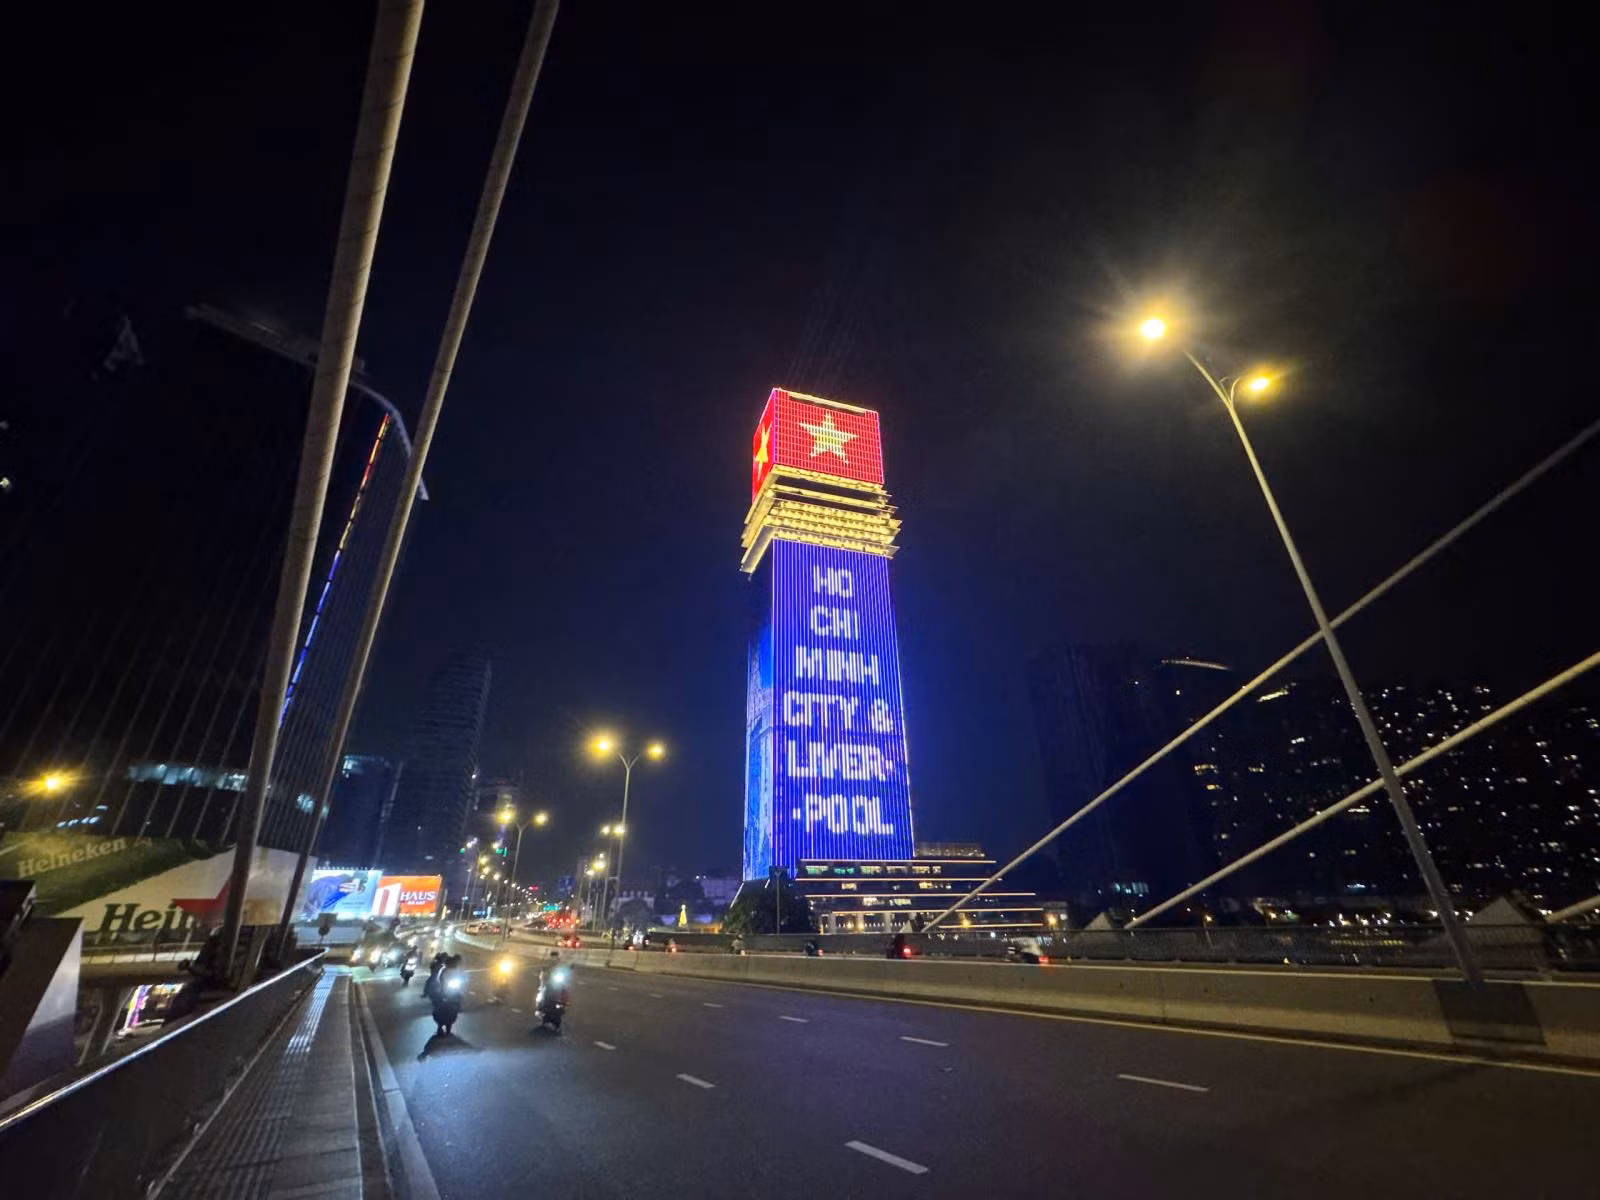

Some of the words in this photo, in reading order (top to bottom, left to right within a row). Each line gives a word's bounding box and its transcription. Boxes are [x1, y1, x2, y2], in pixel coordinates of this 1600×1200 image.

[813, 565, 853, 598] HO
[811, 604, 859, 640] CHI
[795, 645, 879, 685] MINH
[784, 690, 858, 729] CITY
[870, 698, 893, 733] &
[17, 837, 128, 878] Heineken
[400, 891, 436, 901] HAUS
